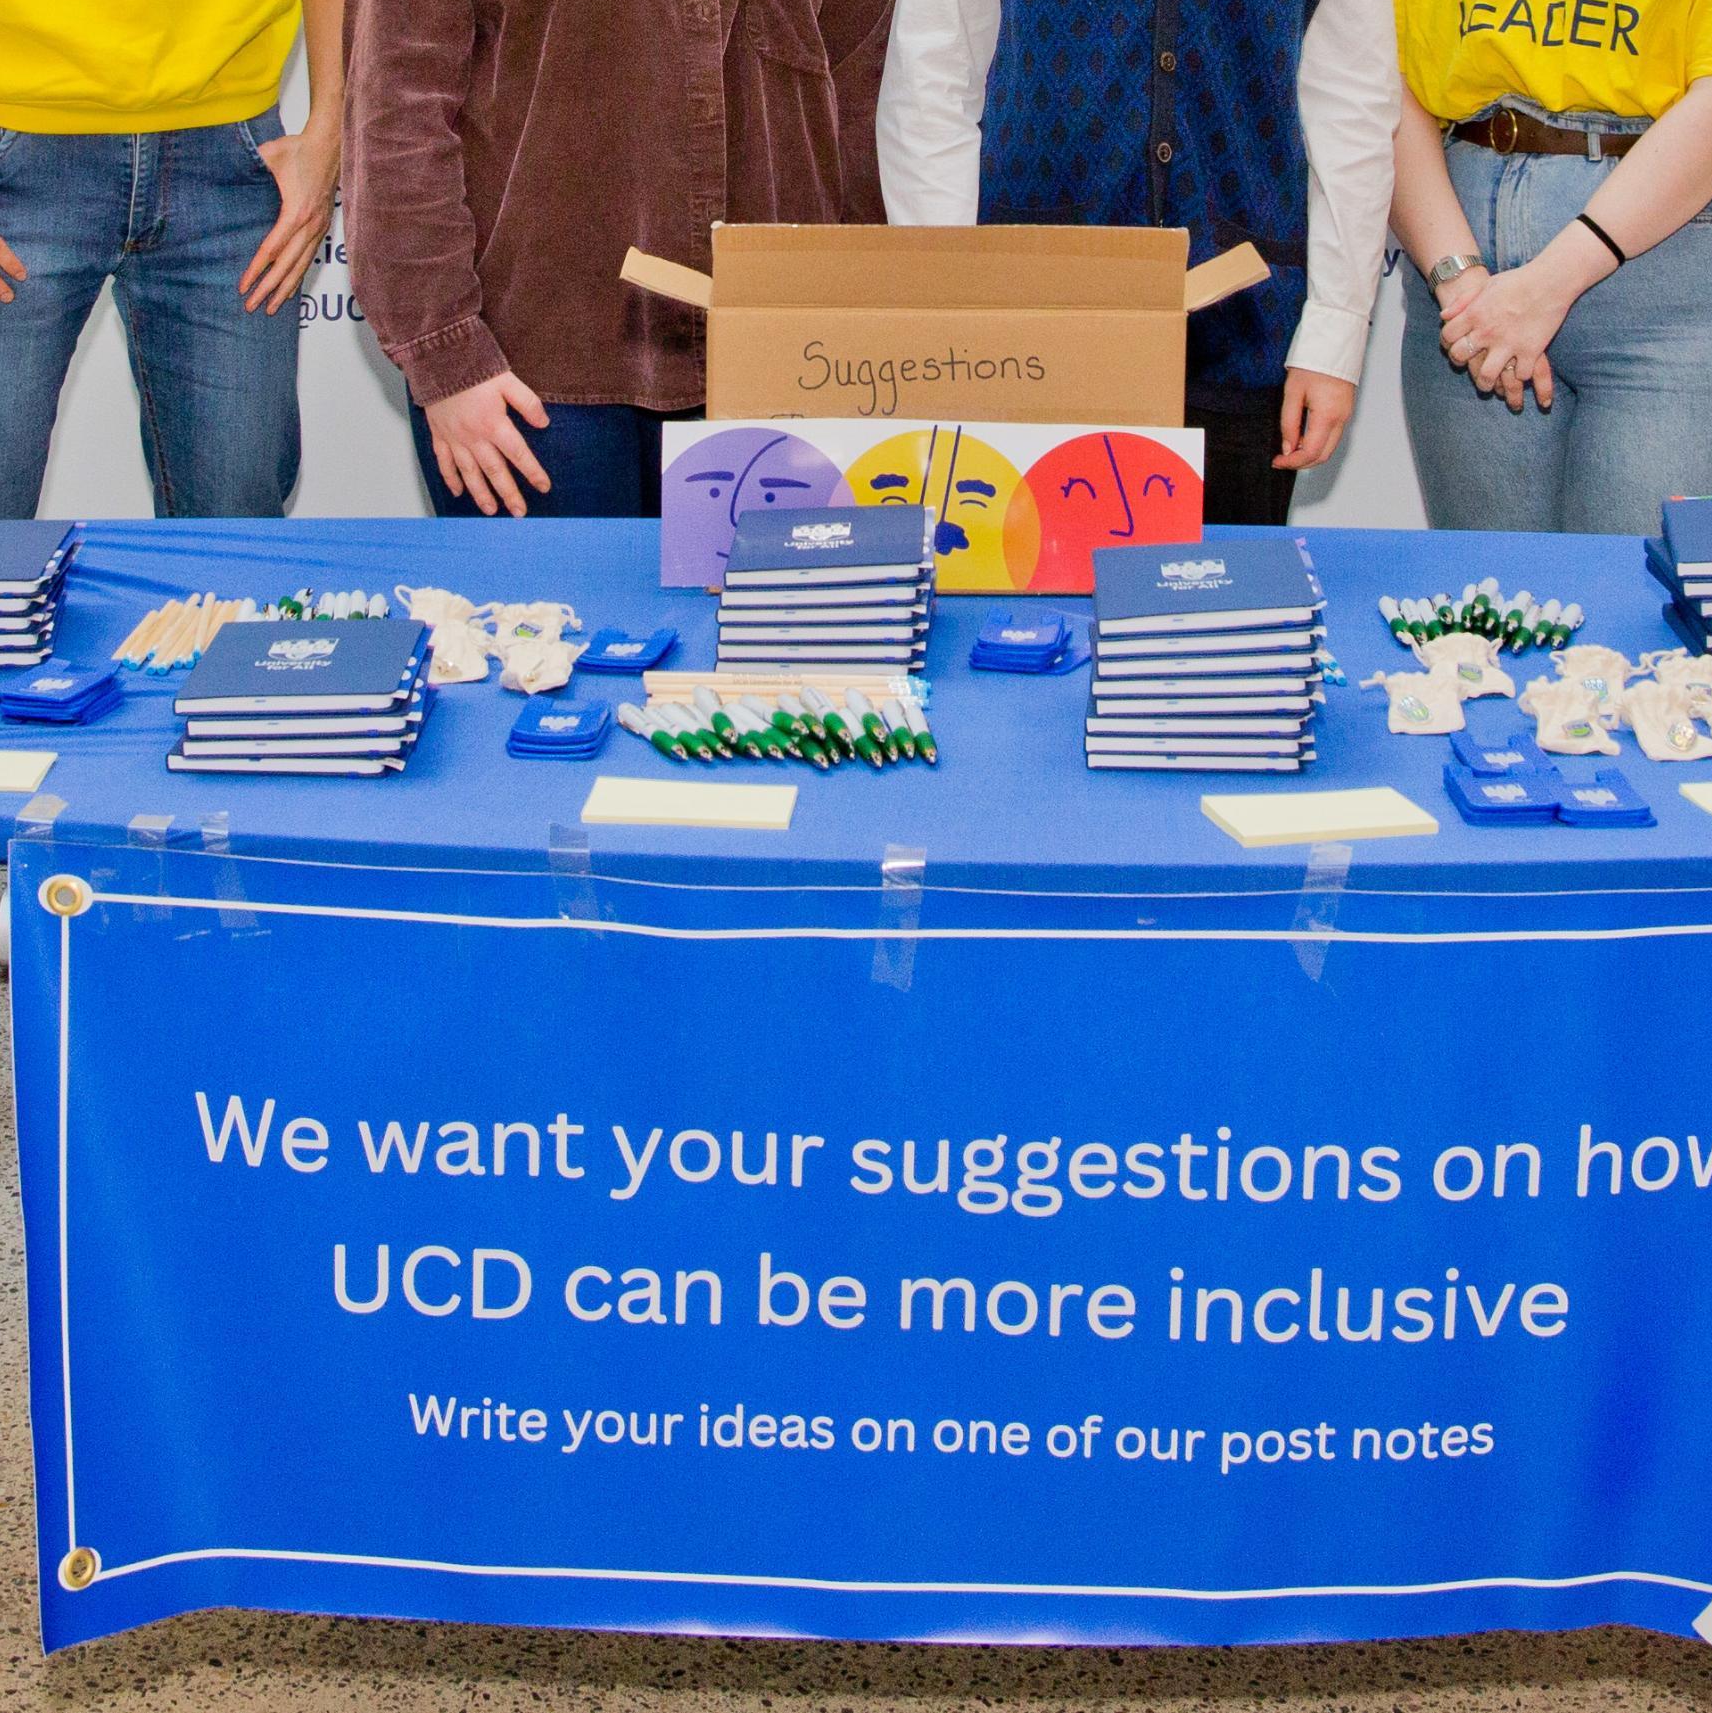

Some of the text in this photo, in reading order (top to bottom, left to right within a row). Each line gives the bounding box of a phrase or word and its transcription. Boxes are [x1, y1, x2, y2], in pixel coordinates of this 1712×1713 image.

[798, 341, 1045, 415] Suggestions
[194, 1091, 329, 1173] We
[358, 1112, 586, 1179] want
[609, 1123, 825, 1202] your
[849, 1125, 1403, 1220] suggestions
[1432, 1140, 1542, 1202] on
[333, 1242, 1569, 1344] UCD can be more inclusive
[408, 1392, 1495, 1474] Write your ideas on one of our post notes
